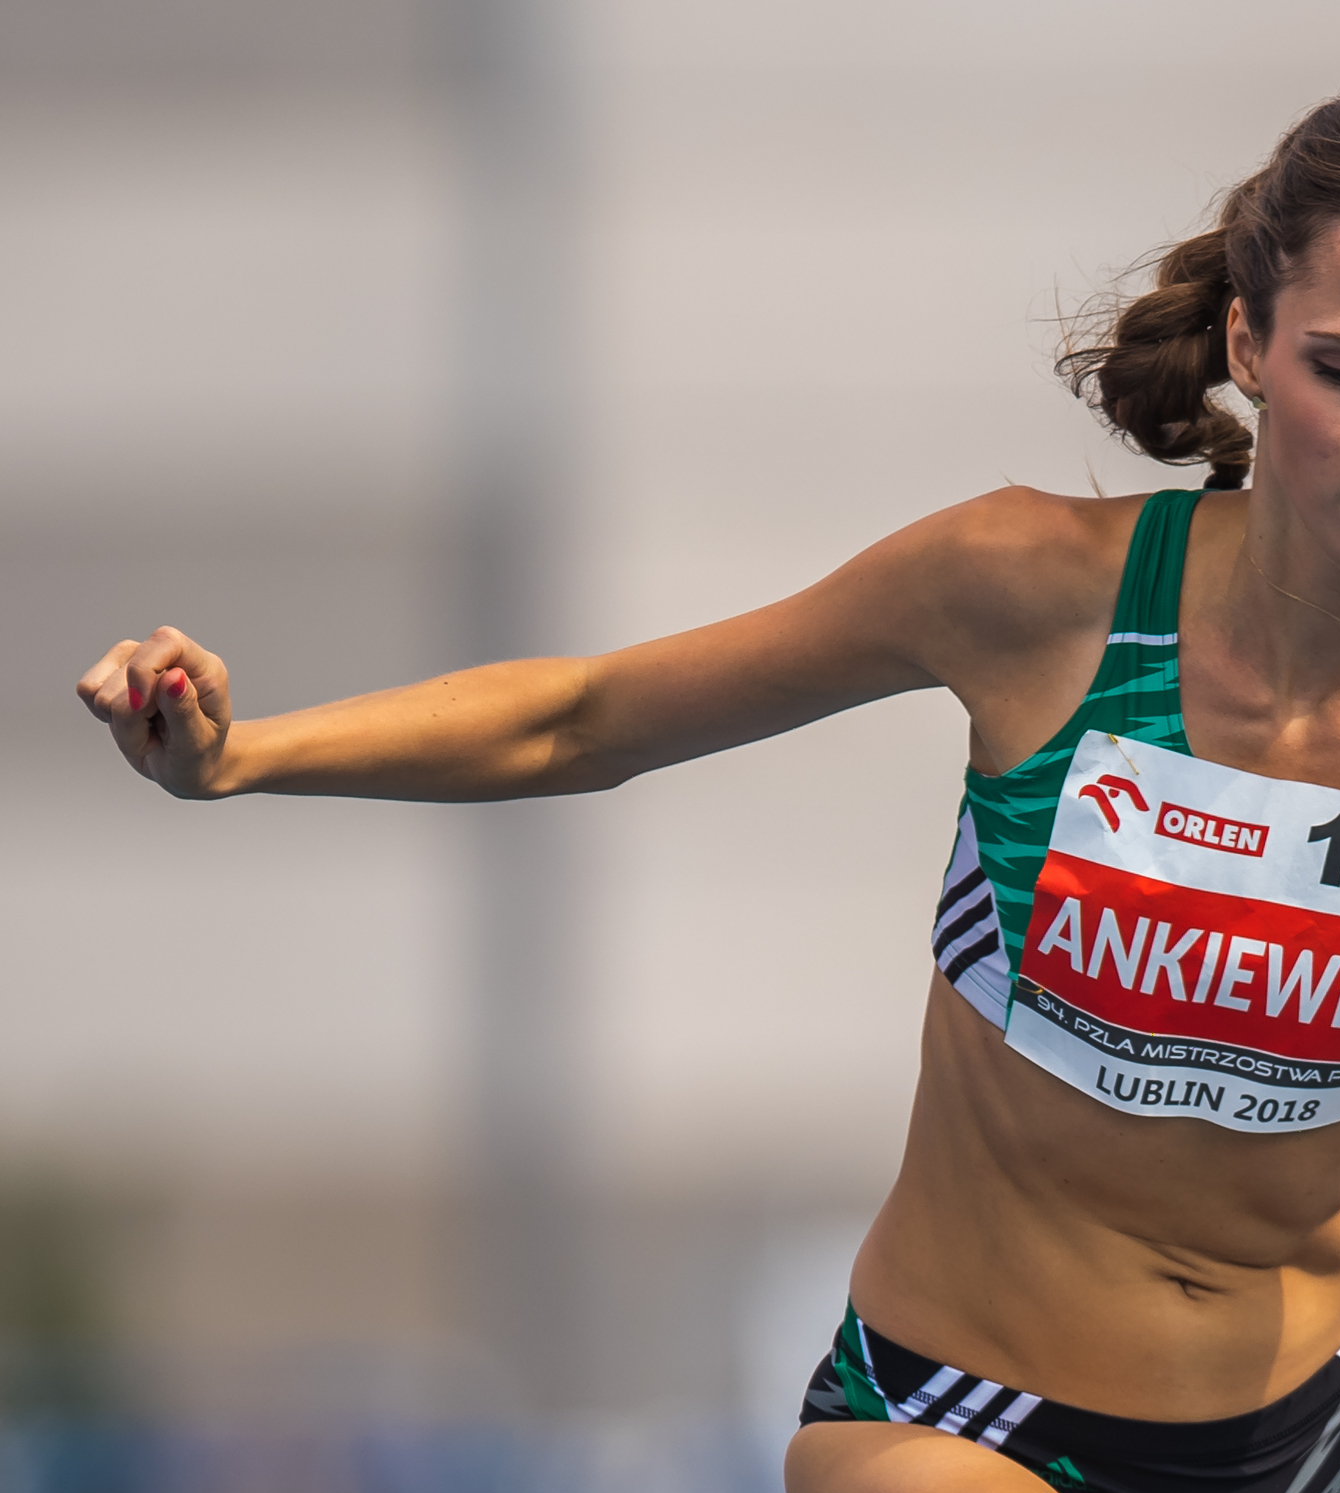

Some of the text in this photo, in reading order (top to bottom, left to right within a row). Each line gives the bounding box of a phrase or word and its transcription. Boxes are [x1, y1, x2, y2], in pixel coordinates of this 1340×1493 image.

[1163, 809, 1261, 852] ORLEN
[1037, 994, 1068, 1024] 94.
[1074, 1016, 1135, 1055] PZLA
[1140, 1042, 1322, 1083] MISTRZOSTWA
[1095, 1064, 1320, 1123] LUBLIN 2018
